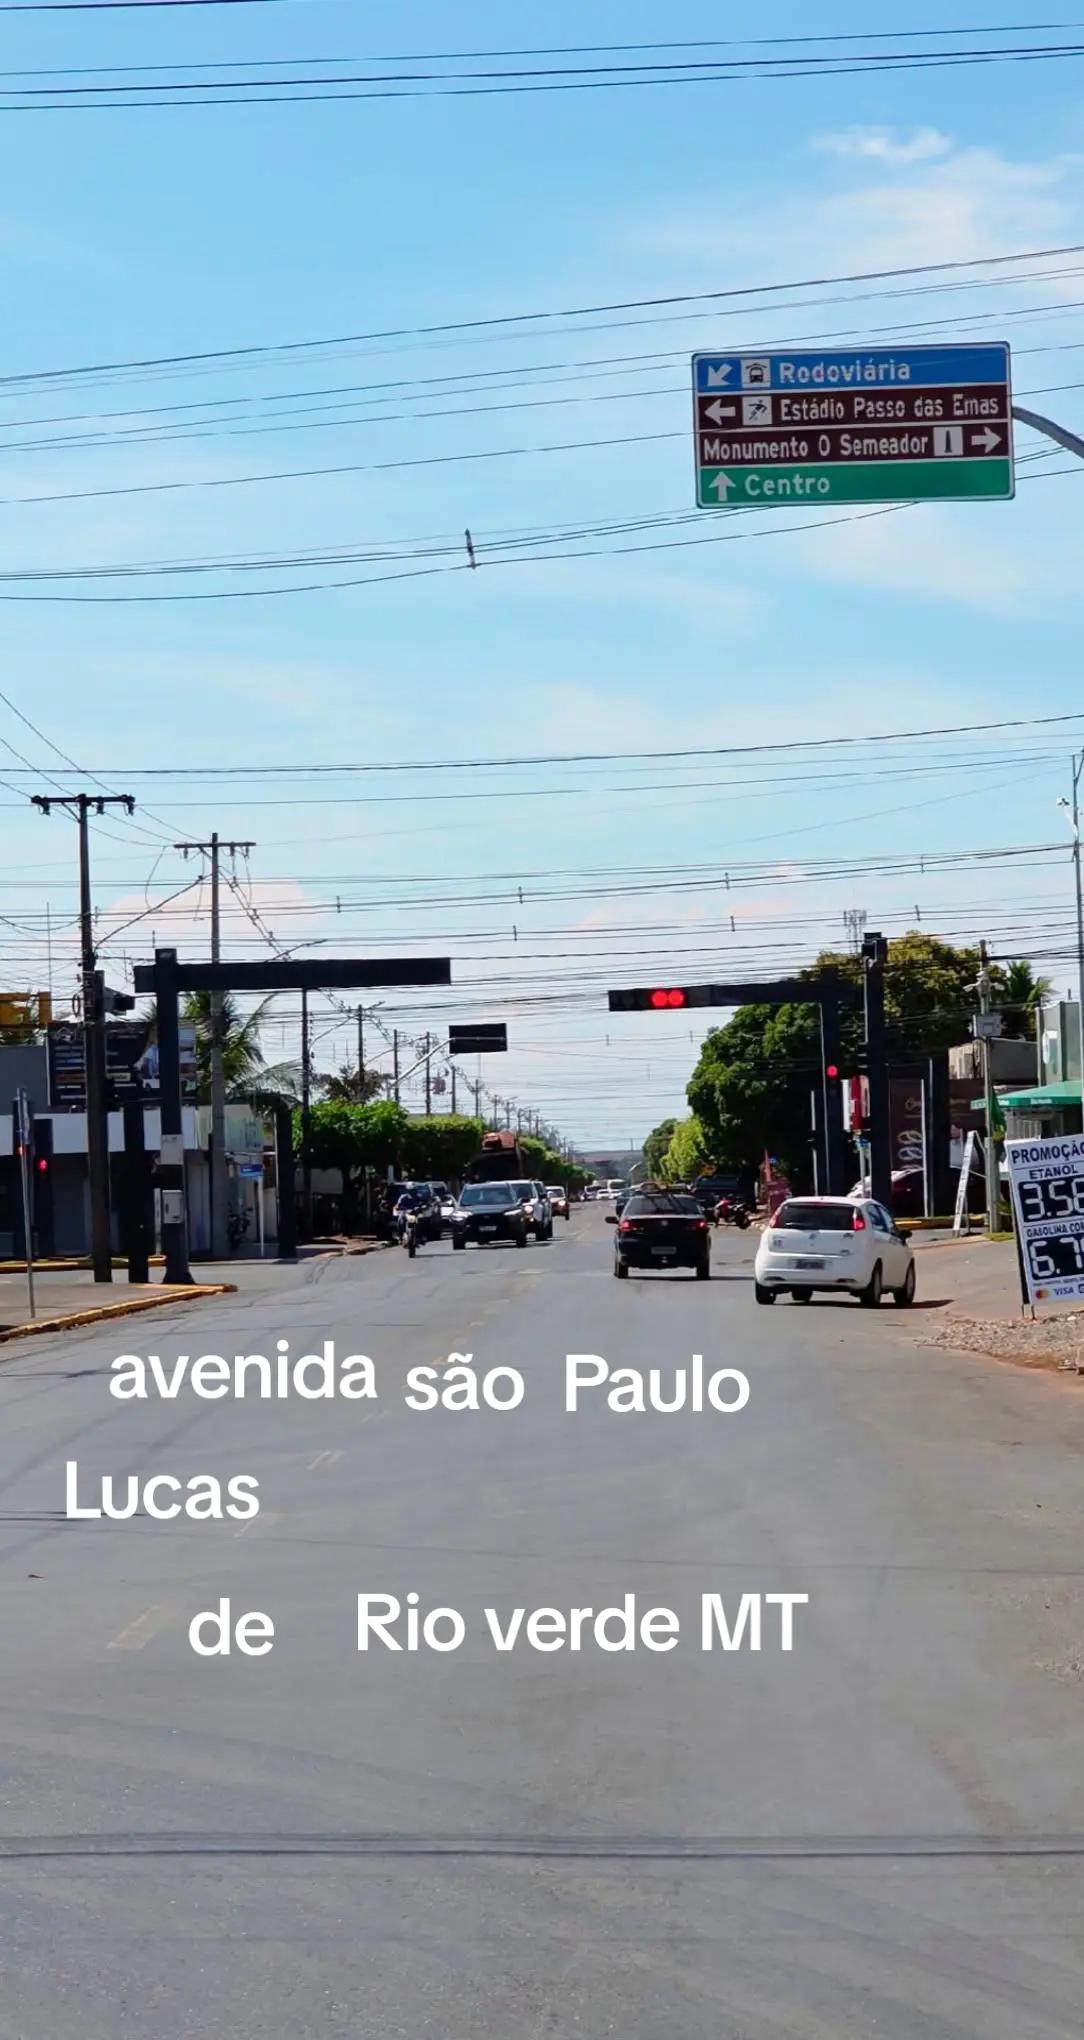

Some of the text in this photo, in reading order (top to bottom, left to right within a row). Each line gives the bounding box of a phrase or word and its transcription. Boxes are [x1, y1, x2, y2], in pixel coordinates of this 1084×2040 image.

[779, 358, 911, 384] Rodoviária
[780, 393, 999, 422] Estádio Passo das Emas
[703, 433, 929, 461] Monumento O Semeador
[744, 474, 830, 496] Centro
[1029, 1165, 1079, 1180] ETANOL
[1026, 1222, 1068, 1238] GASOLINA
[1029, 1236, 1084, 1278] 6.7
[1054, 1286, 1074, 1296] VISA
